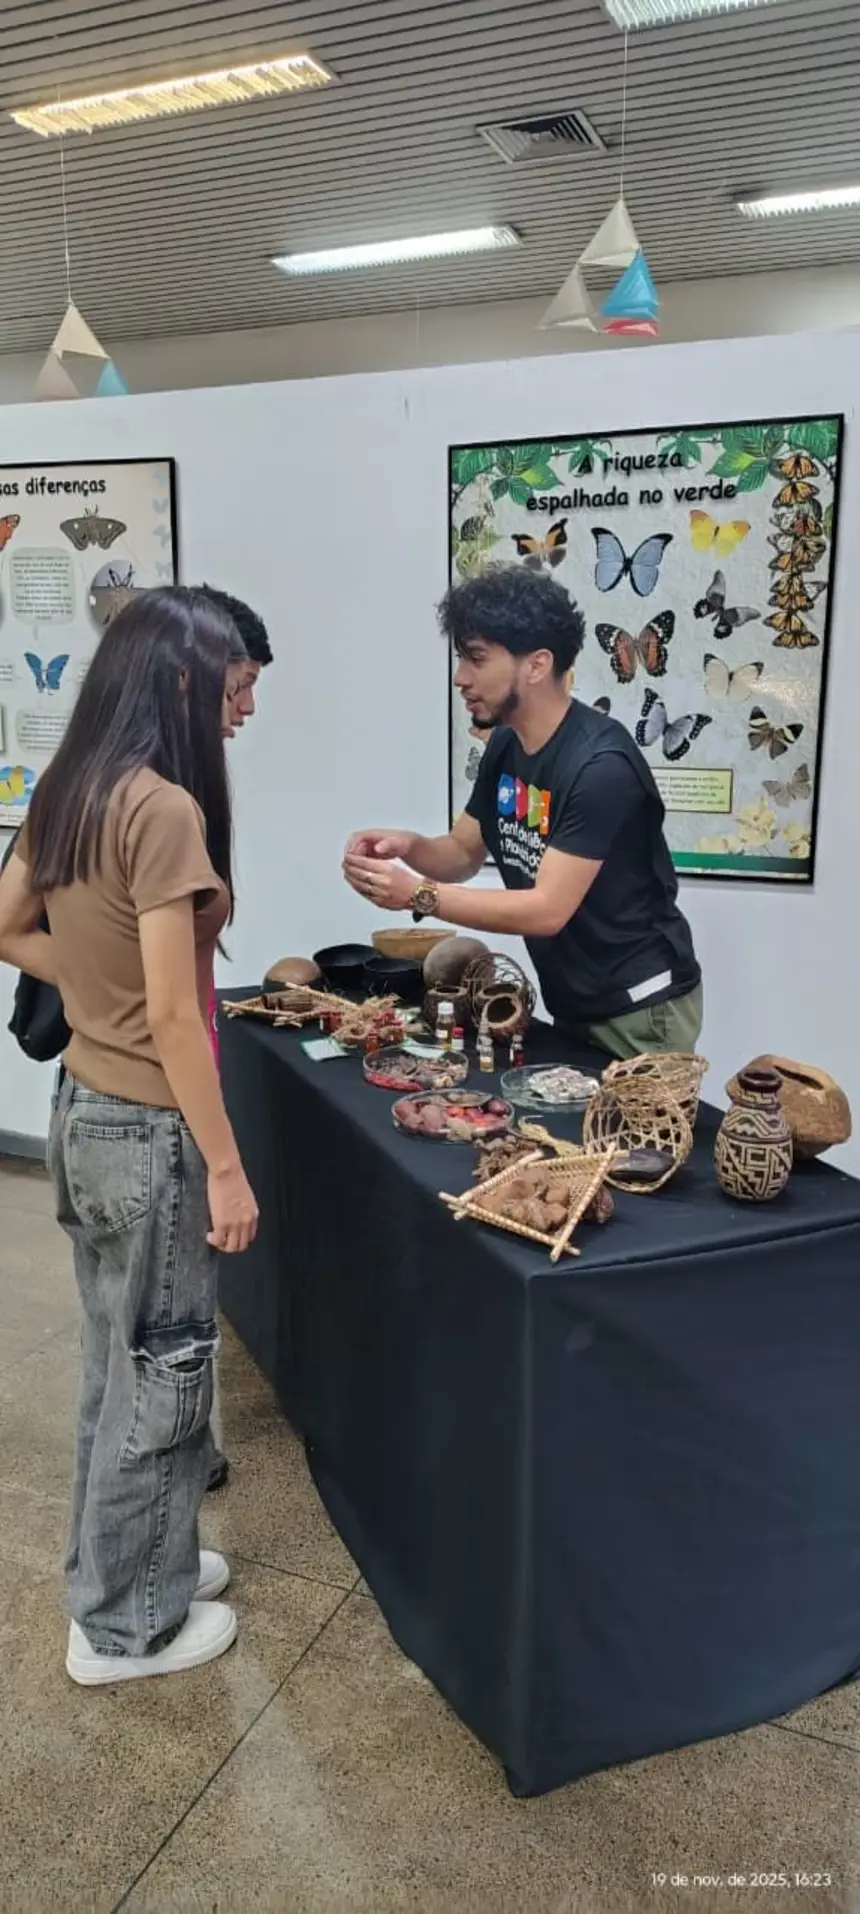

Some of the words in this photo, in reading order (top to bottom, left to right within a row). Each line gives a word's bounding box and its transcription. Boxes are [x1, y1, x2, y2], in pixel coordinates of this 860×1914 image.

[578, 453, 593, 474] A
[603, 452, 683, 476] riqueza
[25, 476, 106, 498] diferenças
[526, 486, 629, 515] espalhada
[639, 489, 663, 505] no
[674, 479, 737, 502] verde
